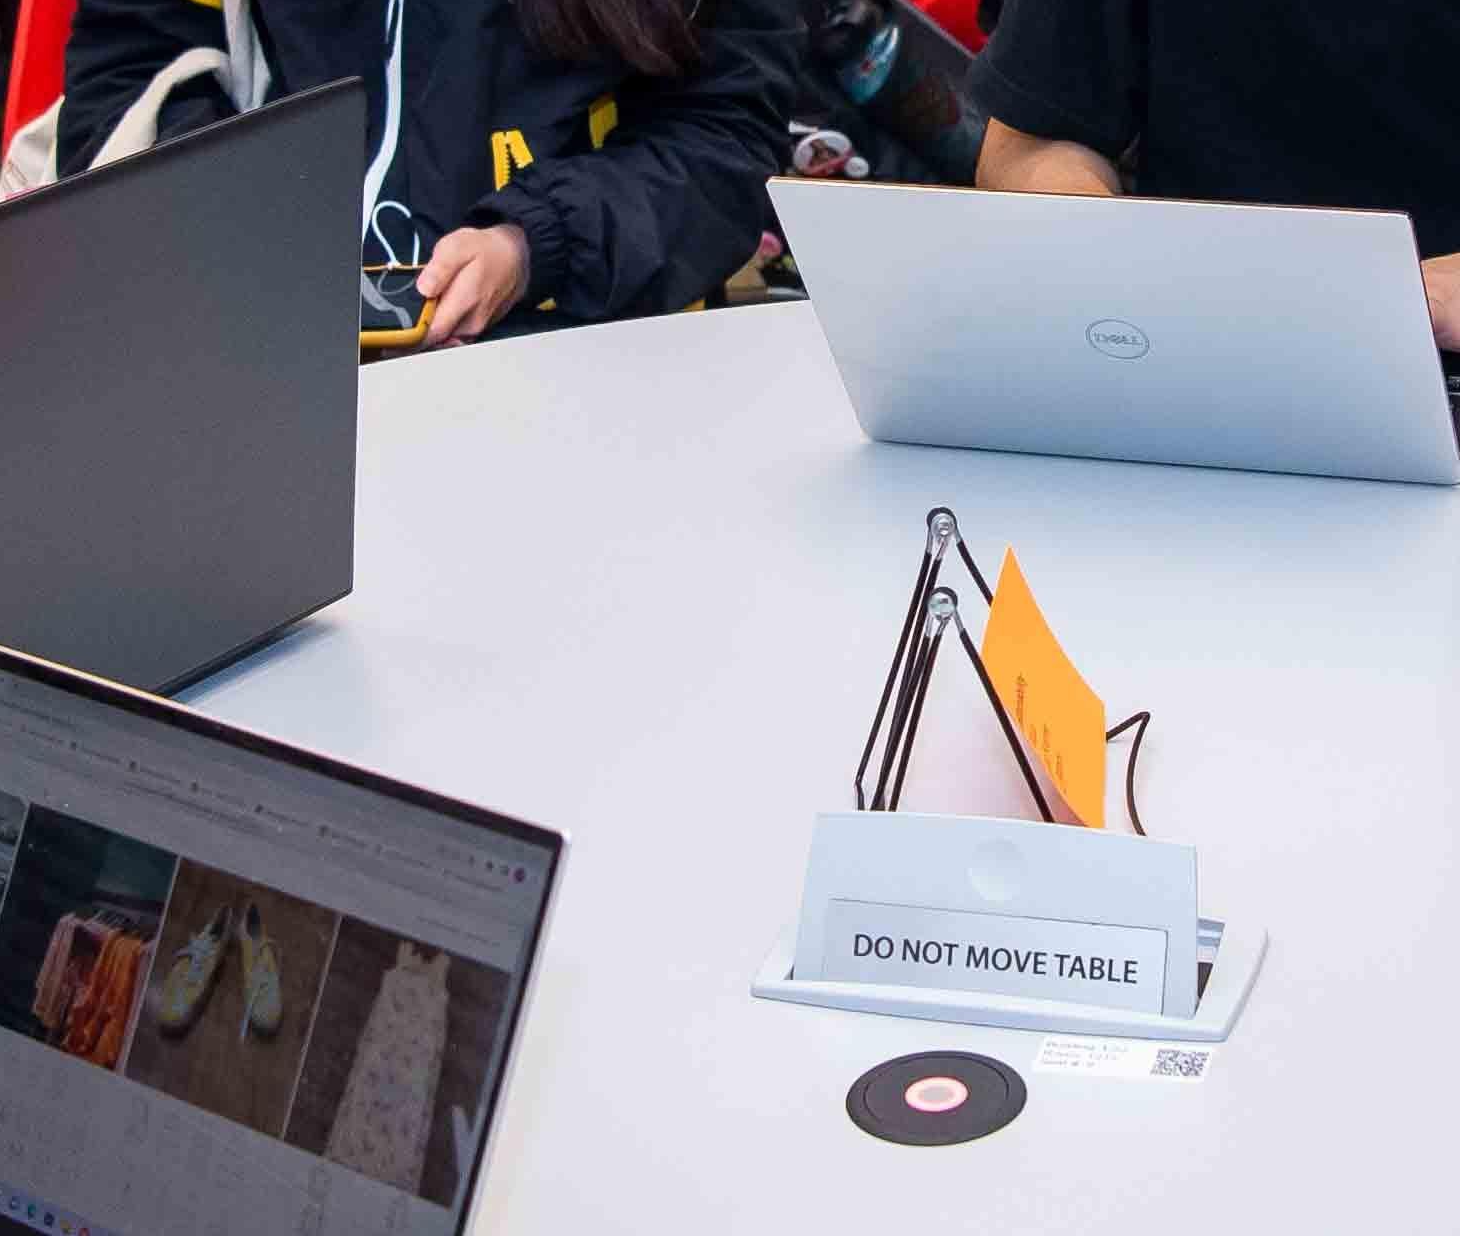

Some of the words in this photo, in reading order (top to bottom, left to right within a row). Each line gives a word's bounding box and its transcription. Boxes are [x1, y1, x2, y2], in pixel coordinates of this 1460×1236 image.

[853, 933, 895, 960] DO
[901, 938, 960, 967] NOT
[965, 945, 1048, 976] MOVE
[1053, 953, 1140, 985] TABLE
